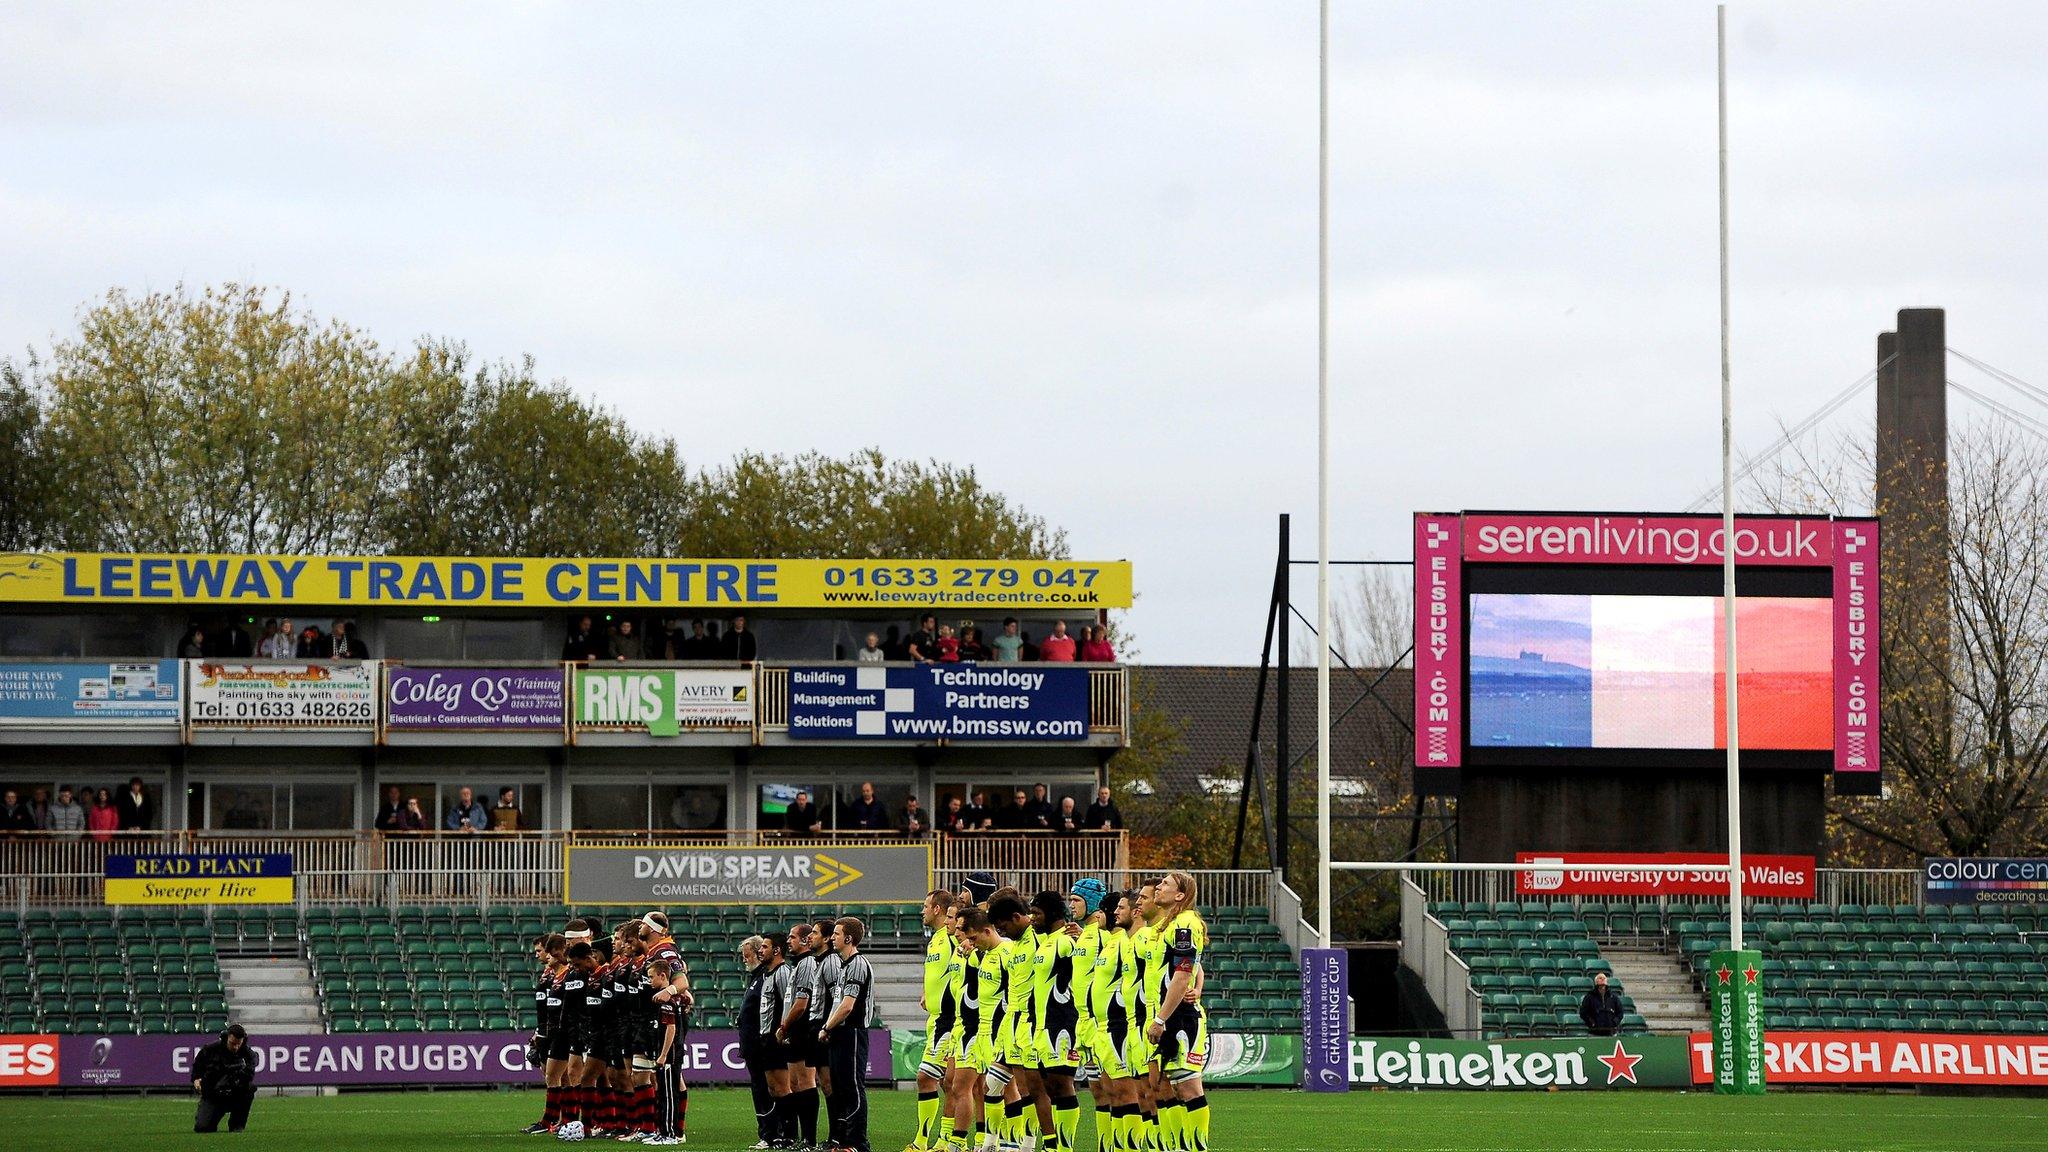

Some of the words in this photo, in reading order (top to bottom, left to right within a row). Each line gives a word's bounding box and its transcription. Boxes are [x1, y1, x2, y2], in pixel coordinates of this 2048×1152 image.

[1478, 518, 1818, 563] serenliving.co.uk
[64, 557, 307, 598] LEEWAY
[327, 561, 524, 600] TRADE
[545, 563, 779, 602] CENTRE
[824, 567, 939, 587] 01633
[952, 567, 1019, 587] 279
[1032, 568, 1100, 587] 047
[824, 590, 1099, 604] www.leewaytradecentre.co.uk
[514, 677, 561, 693] Training
[793, 672, 846, 686] Building
[930, 668, 1044, 690] Technology
[218, 691, 263, 700] Painting
[267, 691, 284, 699] the
[287, 691, 306, 700] sky
[309, 691, 332, 699] with
[390, 673, 462, 711] Coleg
[470, 677, 511, 711] QS
[584, 675, 663, 722] RMS
[681, 686, 726, 697] AVERY
[793, 693, 876, 706] Management
[945, 691, 1030, 709] Partners
[194, 702, 229, 716] Tel:
[237, 703, 294, 717] 01633
[301, 703, 371, 717] 482626
[389, 714, 431, 724] Electrical
[438, 714, 495, 724] Construction
[502, 714, 527, 724] Motor
[531, 714, 561, 724] Vehicle
[793, 715, 853, 728] Solutions
[891, 715, 1083, 735] www.bmssw.com
[135, 858, 191, 875] READ
[199, 858, 265, 875] PLANT
[634, 855, 718, 879] DAVID
[724, 855, 812, 879] SPEAR
[1524, 858, 1533, 889] SPOT
[1750, 866, 1805, 885] Wales
[1928, 858, 2000, 879] colour
[652, 884, 734, 897] COMMERCIAL
[736, 884, 795, 897] VEHICLES
[1536, 877, 1560, 885] USW
[142, 883, 211, 900] Sweeper
[219, 883, 257, 898] Hire
[1976, 891, 2036, 904] decorating
[1329, 957, 1340, 983] CUP
[1329, 987, 1340, 1064] CHALLENGE
[1719, 991, 1734, 1085] Heineken
[1747, 991, 1760, 1085] Heineken
[375, 1044, 490, 1071] RUGBY
[1348, 1040, 1589, 1087] Heineken
[1693, 1041, 1883, 1074] TRKISH
